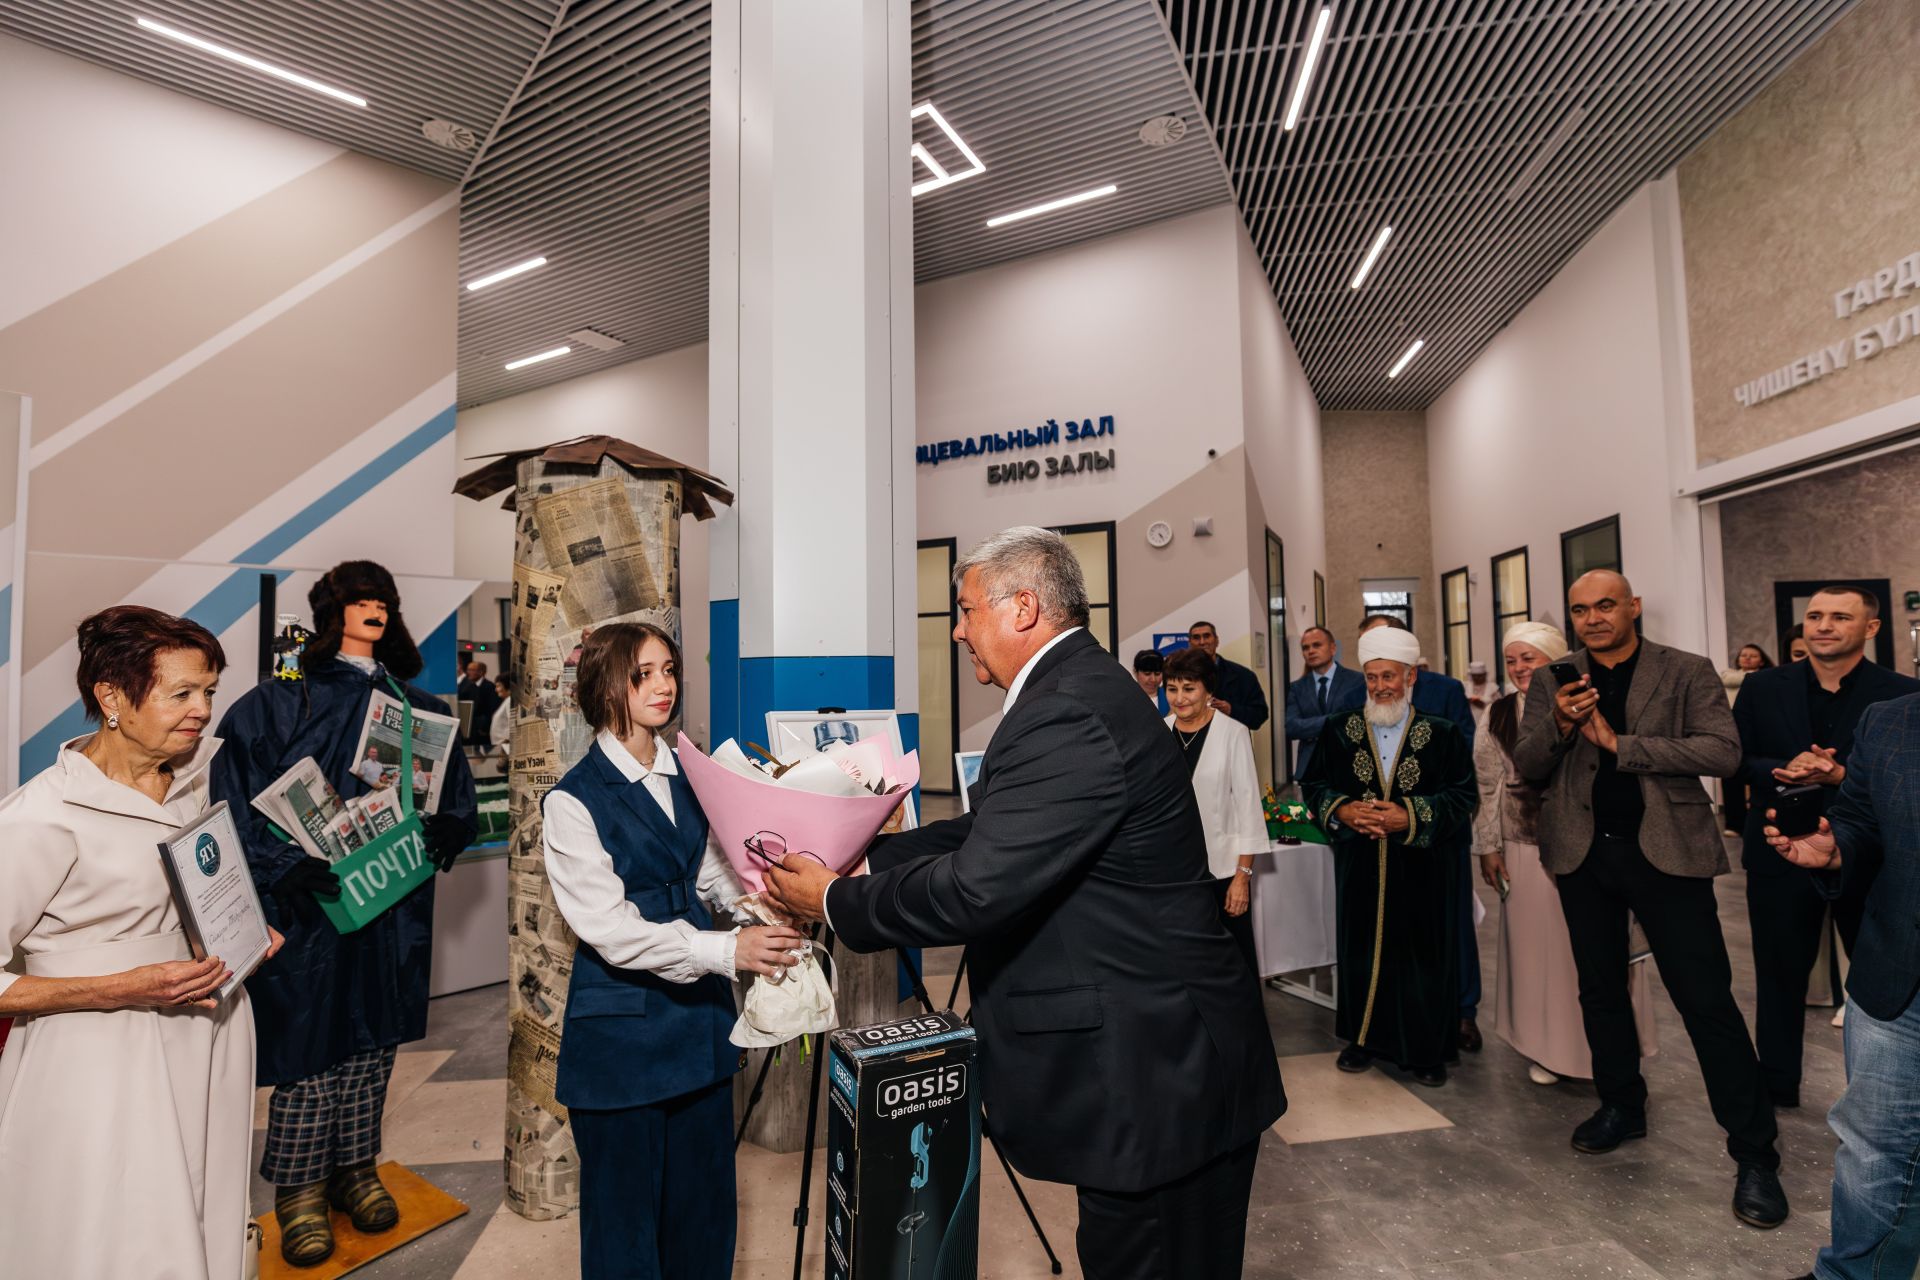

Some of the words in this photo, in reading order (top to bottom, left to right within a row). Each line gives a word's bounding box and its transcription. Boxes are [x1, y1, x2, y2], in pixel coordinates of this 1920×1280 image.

[1065, 415, 1114, 441] ЗАЛ
[987, 459, 1040, 484] БИЮ
[1045, 449, 1115, 477] ЗАЛЫ
[343, 830, 426, 907] ПОЧТА
[865, 1018, 941, 1041] oasis
[880, 1034, 916, 1046] garden
[915, 1028, 941, 1039] tools
[835, 1063, 853, 1091] oasis
[884, 1067, 960, 1106] oasis
[890, 1099, 926, 1120] garden
[927, 1095, 952, 1110] tools
